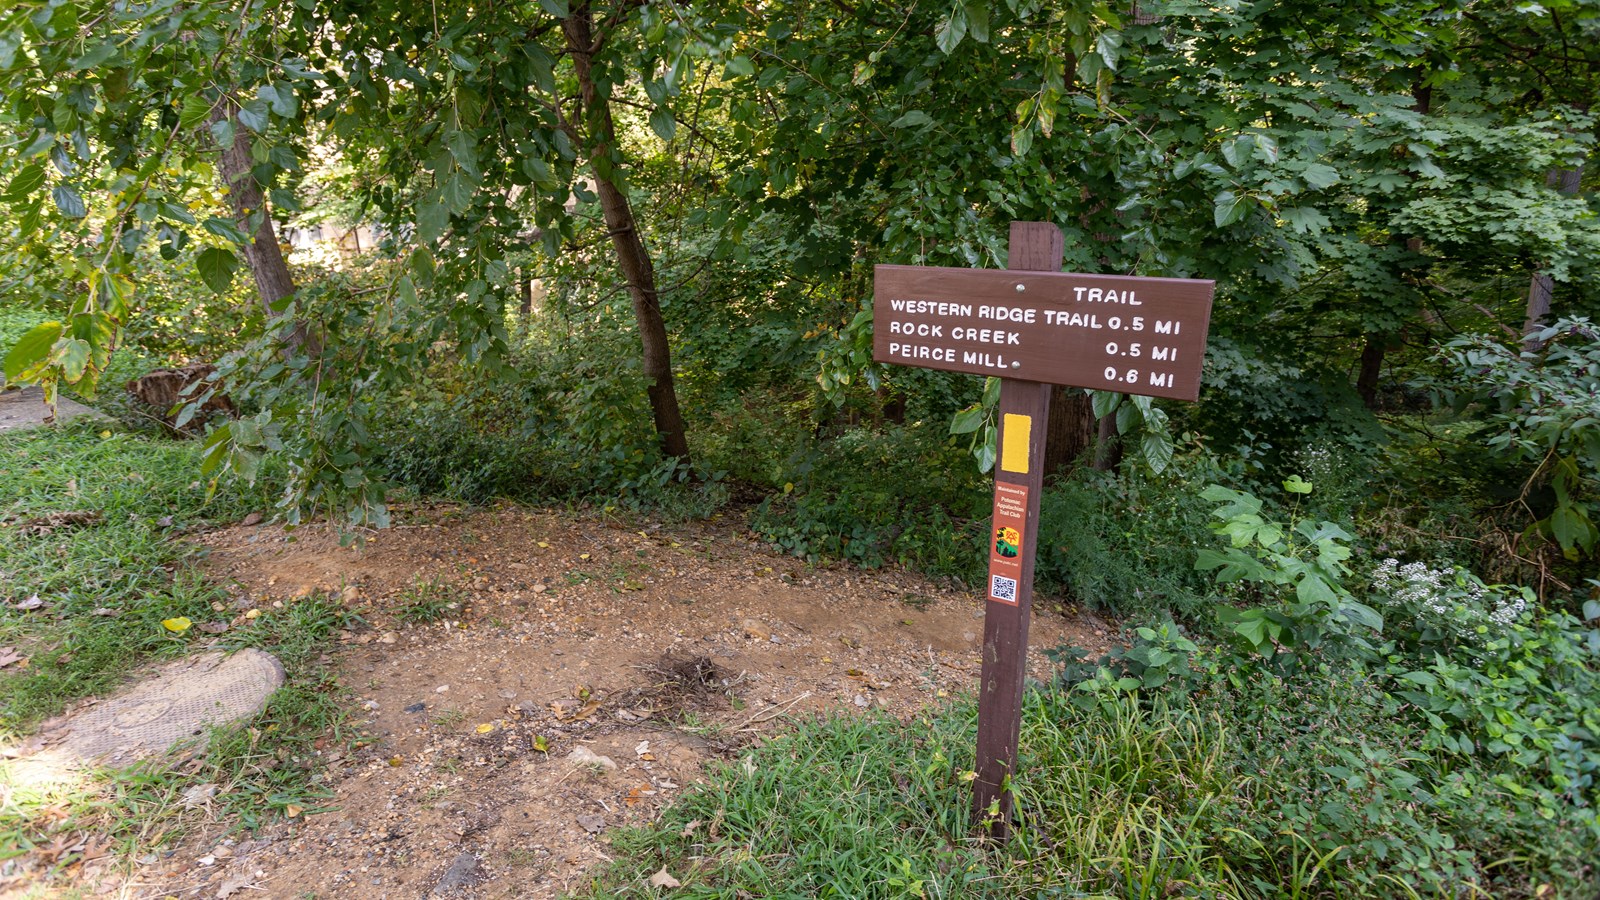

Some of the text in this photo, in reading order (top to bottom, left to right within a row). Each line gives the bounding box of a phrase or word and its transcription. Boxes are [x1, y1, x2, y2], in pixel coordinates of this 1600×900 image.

[1073, 287, 1142, 305] TRAIL
[890, 300, 1180, 335] WESTERN RIDGE TRAIL 0.5 MI
[890, 321, 1177, 361] ROCK CREEK 0.5 MI
[889, 343, 1174, 388] PEIRCE MILL 0.6 MI
[997, 486, 1020, 494] Maintained
[996, 502, 1024, 512] Appalachian
[1001, 496, 1021, 505] Potomac
